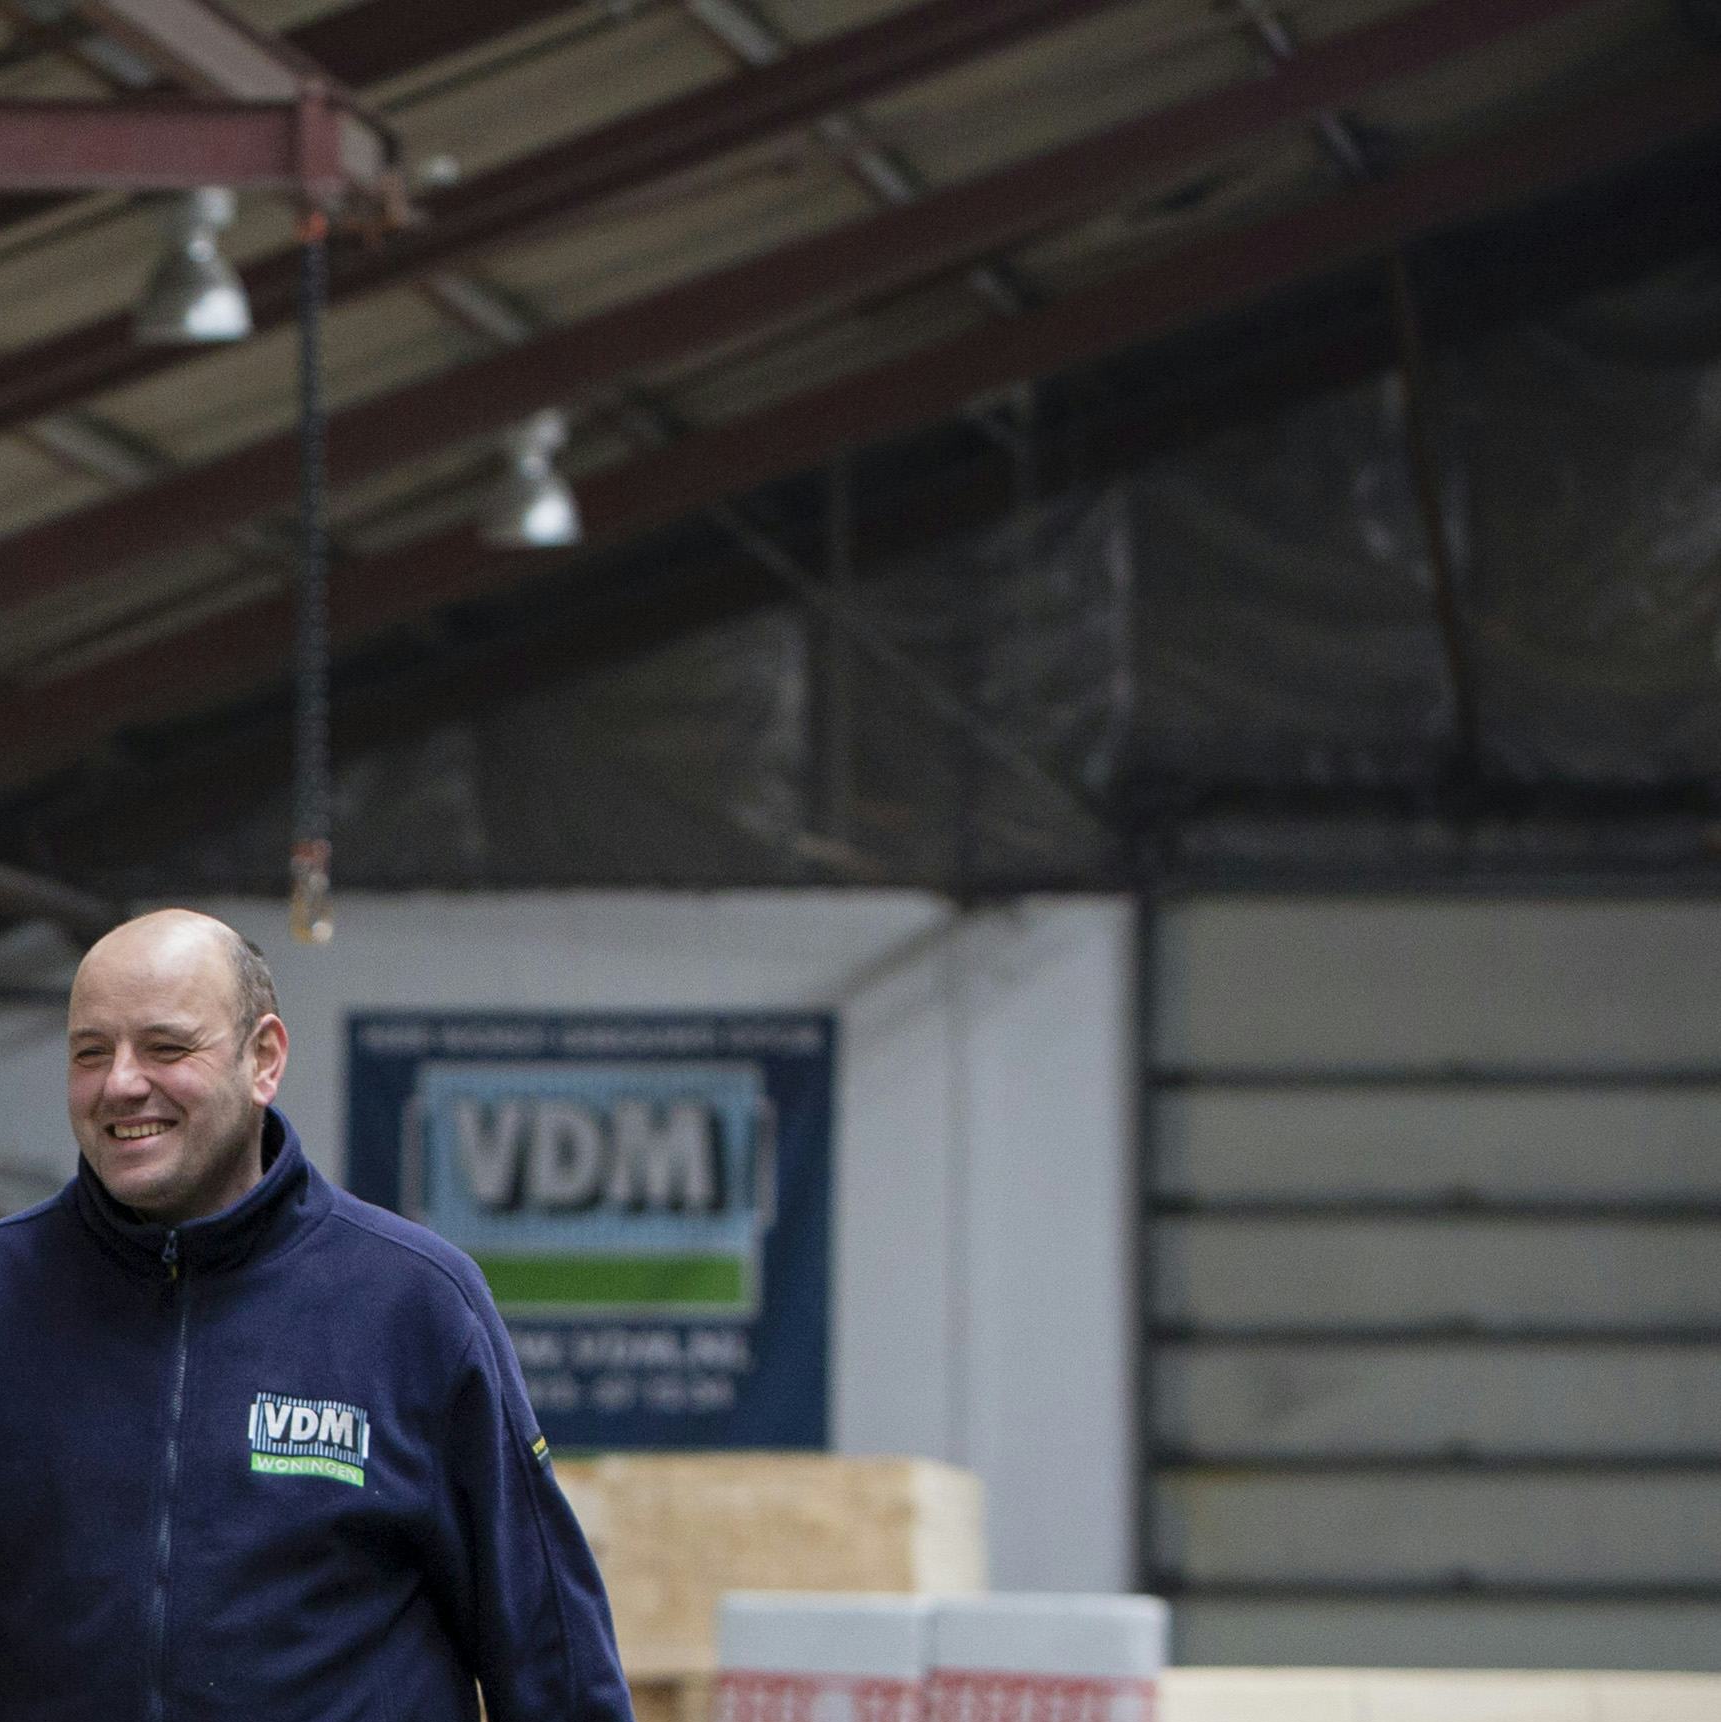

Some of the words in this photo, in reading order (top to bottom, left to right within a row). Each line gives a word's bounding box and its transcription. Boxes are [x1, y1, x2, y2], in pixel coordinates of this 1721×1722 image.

[460, 1098, 715, 1203] VDM
[263, 1401, 354, 1449] VDM
[257, 1455, 358, 1481] WONINGEN
